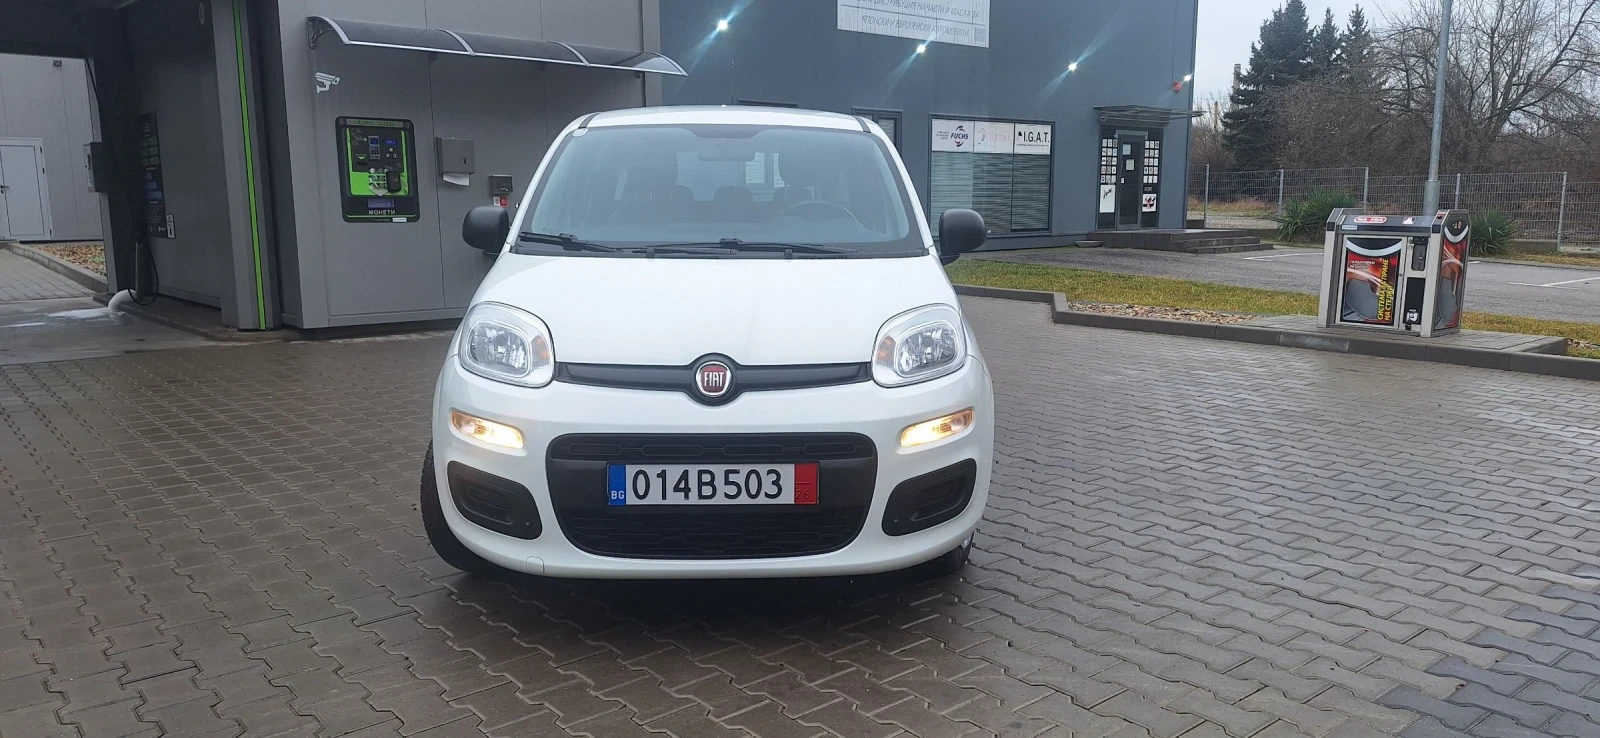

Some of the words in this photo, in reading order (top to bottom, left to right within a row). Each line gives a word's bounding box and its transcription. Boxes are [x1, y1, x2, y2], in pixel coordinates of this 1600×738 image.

[861, 15, 889, 27] ЯПОНСКИ
[950, 132, 969, 140] FUCHS
[1381, 258, 1389, 280] ПРАНЕ
[1377, 290, 1386, 320] СИСТЕМА
[1384, 311, 1391, 321] НА
[704, 371, 725, 387] FIAT
[632, 468, 783, 501] 014B503
[611, 490, 625, 500] BG
